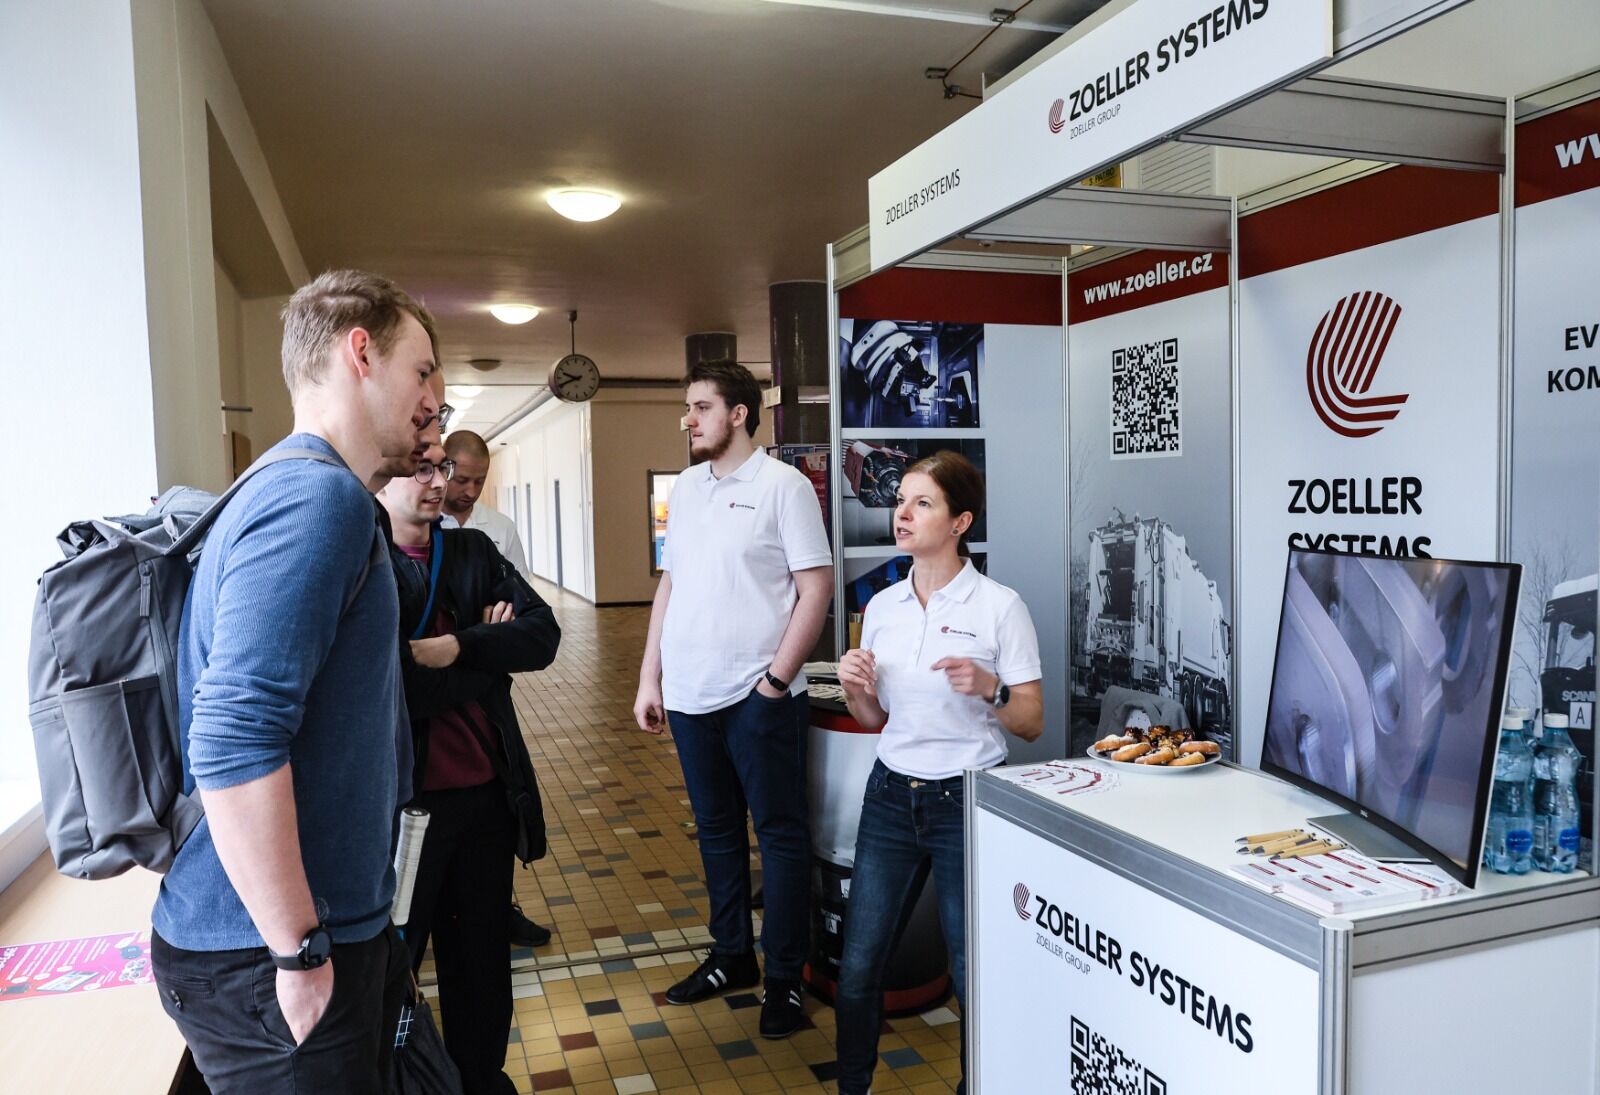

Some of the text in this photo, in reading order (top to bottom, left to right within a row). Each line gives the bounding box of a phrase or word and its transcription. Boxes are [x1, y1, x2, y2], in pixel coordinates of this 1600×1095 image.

[1069, 0, 1269, 122] ZOELLER SYSTEMS
[1070, 104, 1121, 140] ZOELLER GROUP
[886, 168, 961, 226] ZOELLER SYSTEMS
[1084, 252, 1213, 305] www.zoeller.cz
[1565, 323, 1599, 351] EV
[1287, 476, 1423, 515] ZOELLER
[1035, 895, 1254, 1053] ZOELLER SYSTEMS
[1036, 932, 1091, 976] ZOELLER GROUP
